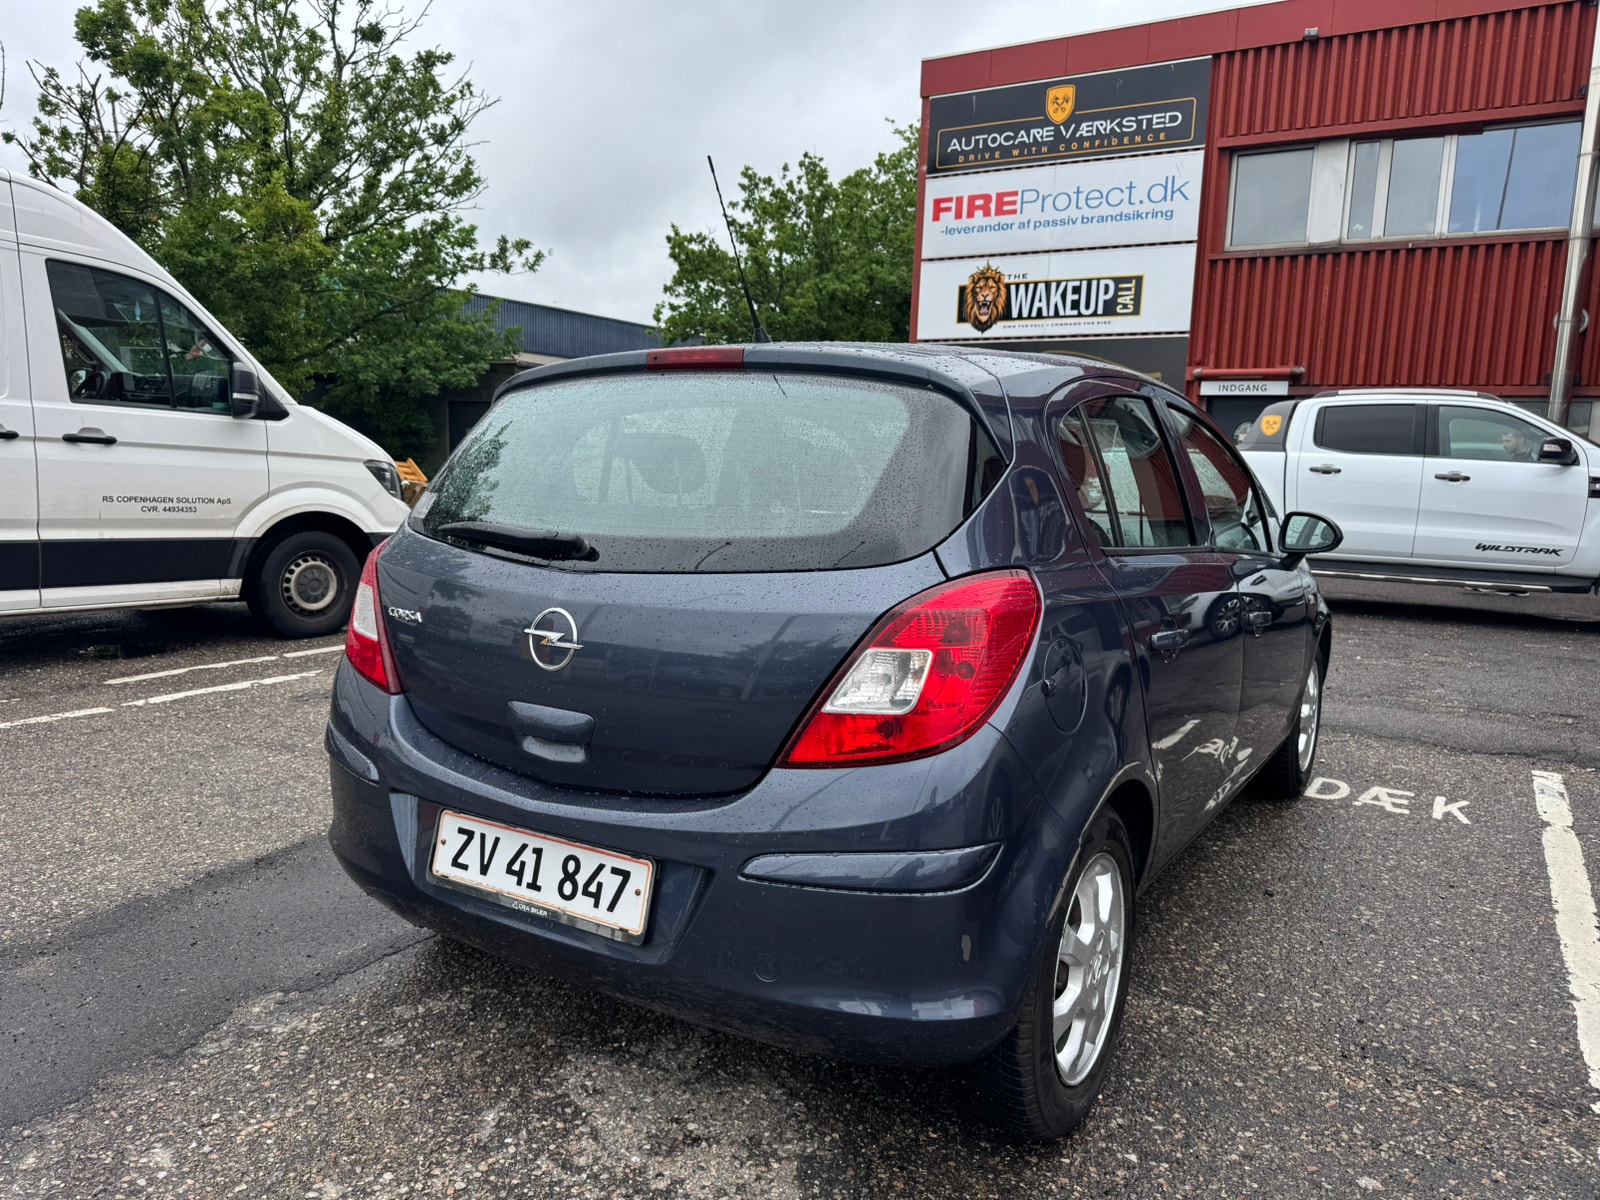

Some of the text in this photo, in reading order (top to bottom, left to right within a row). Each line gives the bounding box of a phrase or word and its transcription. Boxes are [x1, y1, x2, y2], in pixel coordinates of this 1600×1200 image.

[947, 111, 1182, 153] AUTOCARE VÆRKSTED
[958, 132, 1166, 163] DRIVE WITH CONFIDENCE
[931, 175, 1191, 222] FIREProtect.dk
[1018, 219, 1031, 230] af
[1033, 214, 1078, 231] passiv
[1081, 208, 1174, 225] brandsikring
[1009, 279, 1115, 319] WAKEUP
[1116, 279, 1136, 314] CALL
[1218, 384, 1267, 392] INDGANG
[102, 495, 231, 506] RS COPENHAGEN SOLUTION ApS
[1475, 542, 1564, 556] WILDTRAK
[388, 606, 422, 623] CORSA
[1303, 776, 1471, 825] DÆK
[451, 826, 631, 912] ZV 41 847
